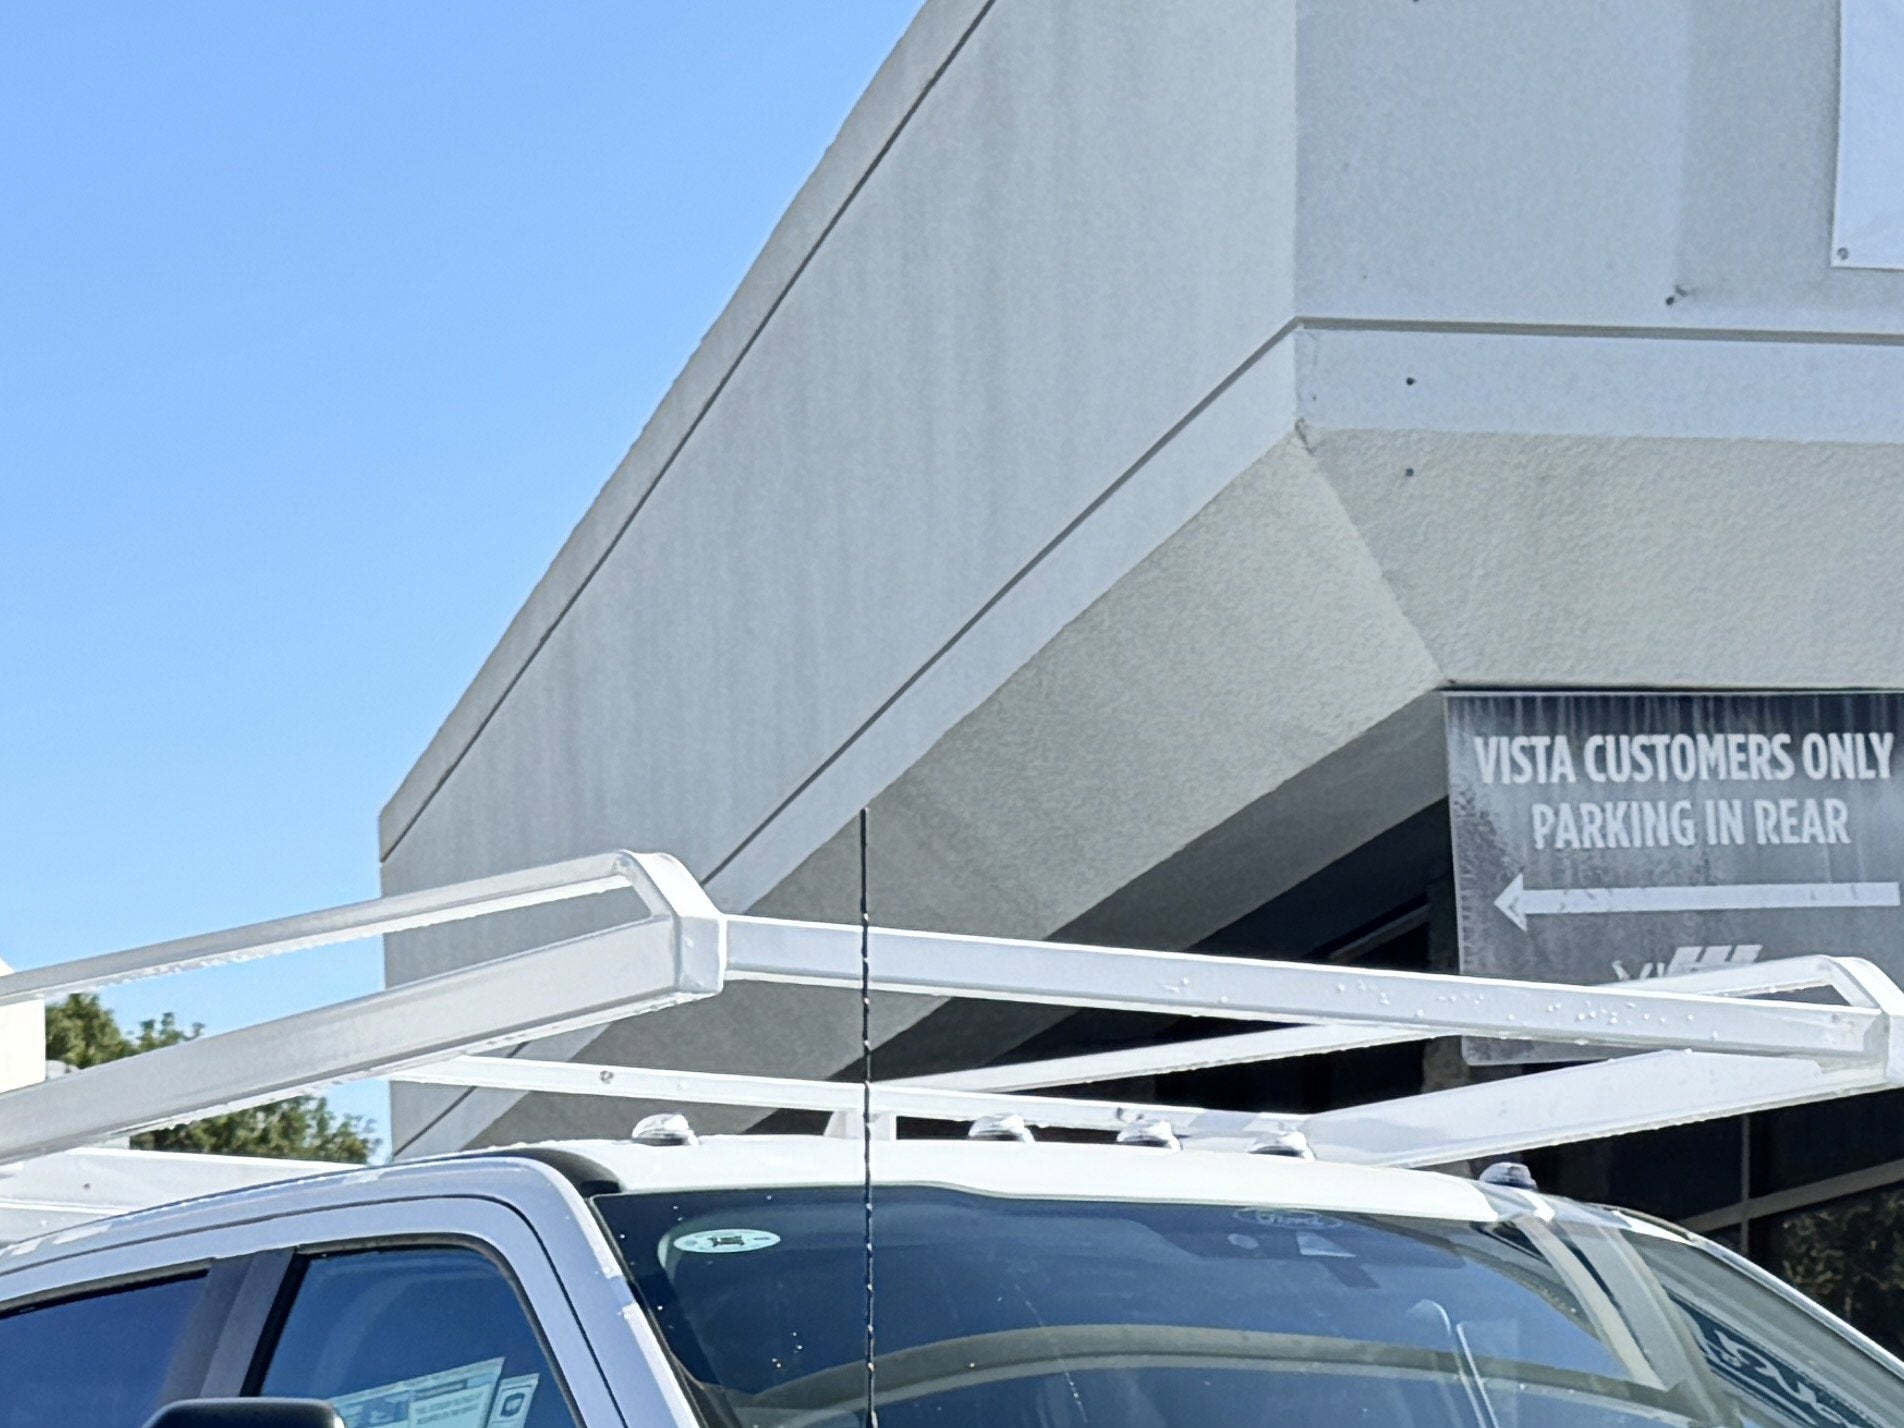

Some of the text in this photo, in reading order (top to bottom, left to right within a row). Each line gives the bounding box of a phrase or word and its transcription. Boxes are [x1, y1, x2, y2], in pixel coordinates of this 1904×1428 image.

[1473, 732, 1894, 785] VISTA CUSTOMERS ONLY
[1532, 799, 1851, 850] PARKING IN REAR
